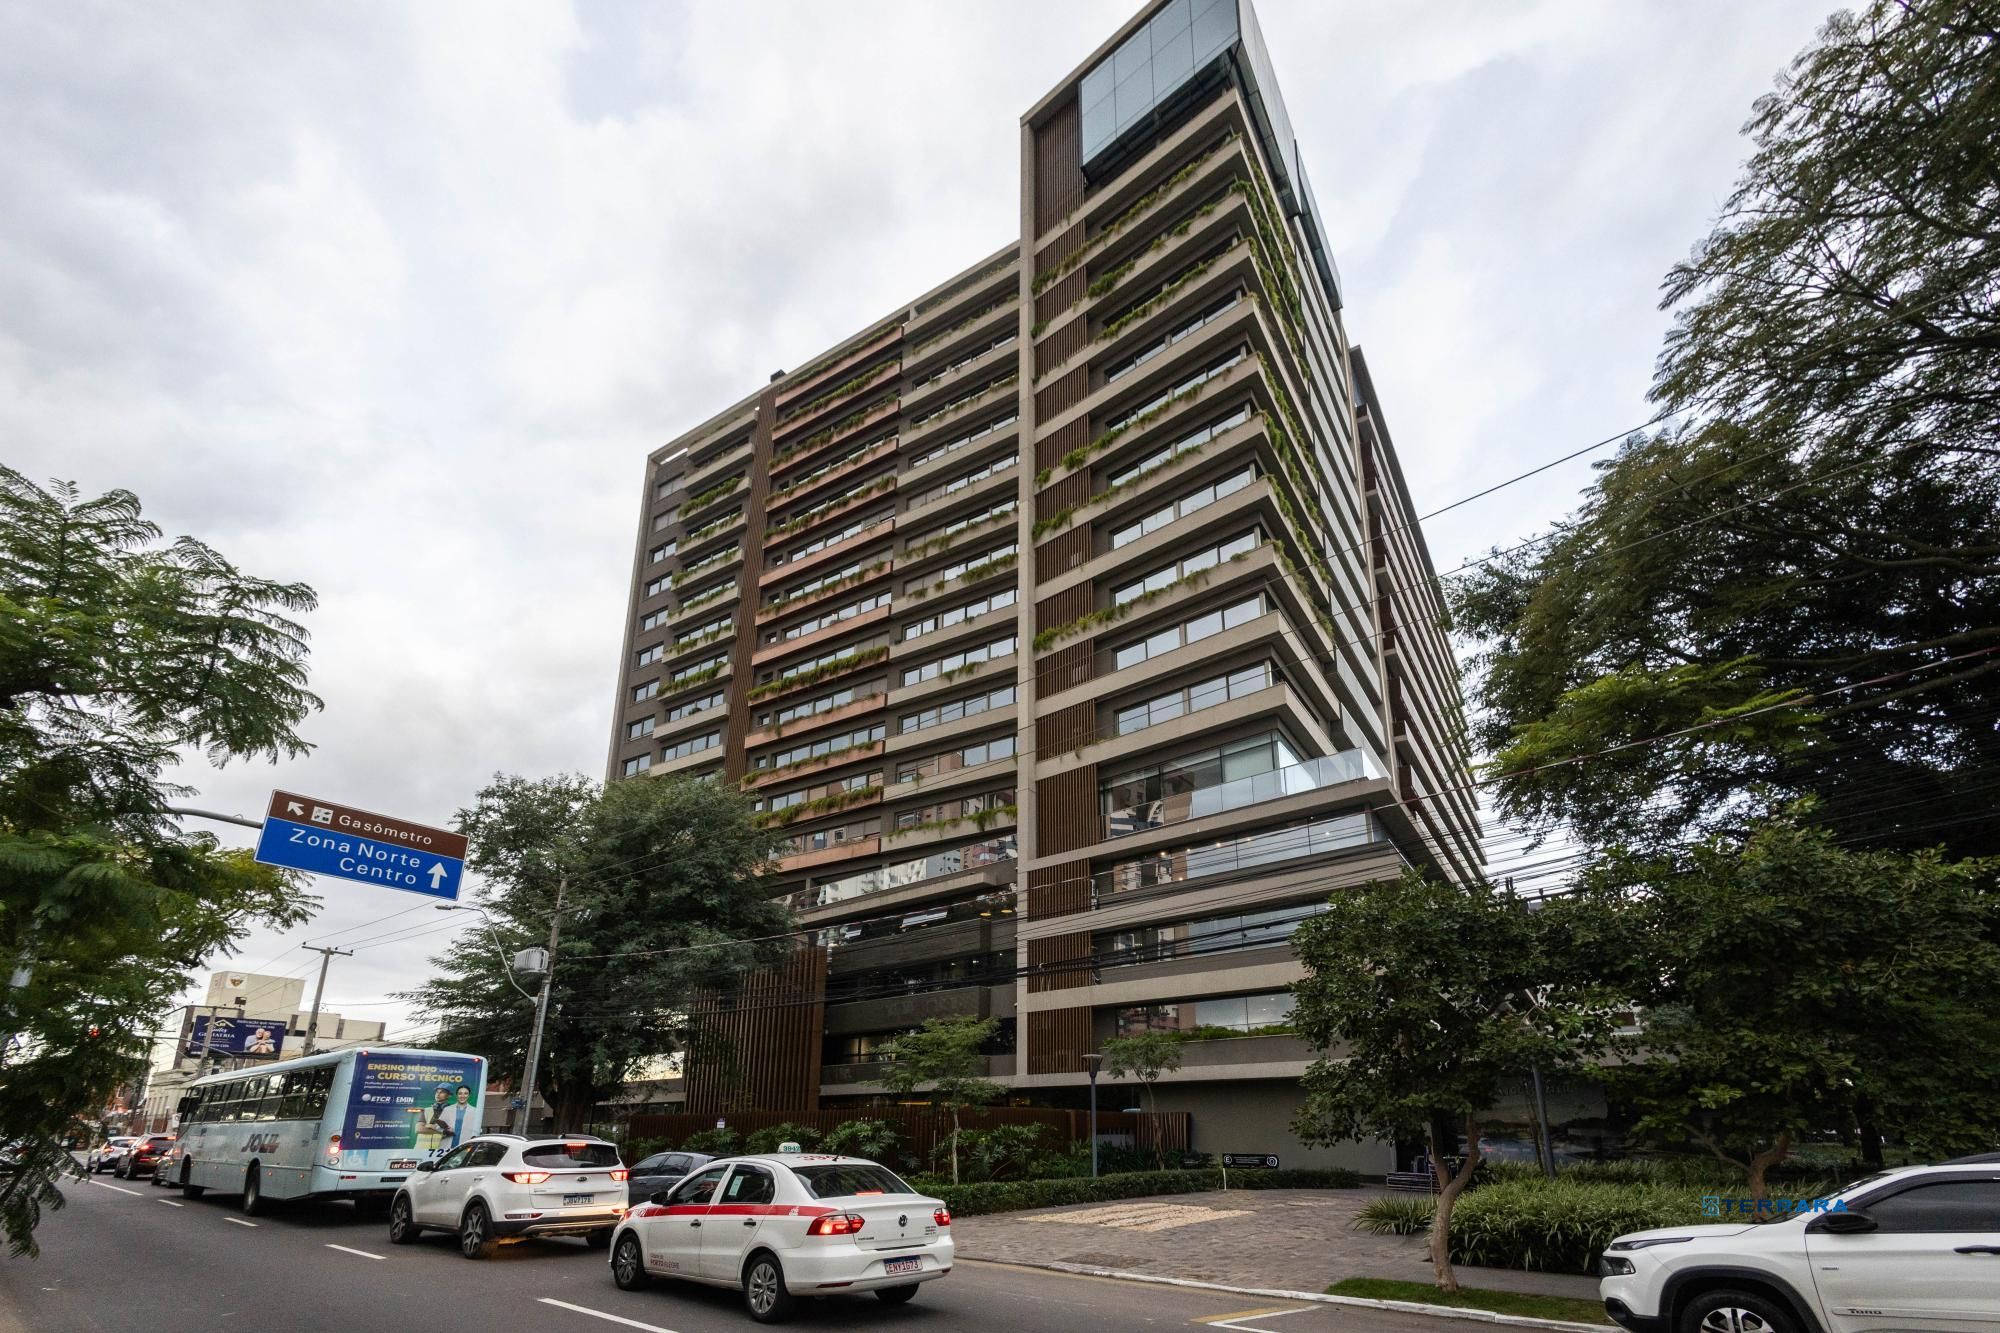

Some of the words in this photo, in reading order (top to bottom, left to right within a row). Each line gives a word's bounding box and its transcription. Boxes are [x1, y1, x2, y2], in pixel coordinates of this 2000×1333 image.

[339, 815, 432, 845] Gasômetro
[290, 828, 351, 853] Zona
[357, 843, 421, 868] Norte
[339, 857, 417, 885] Centro
[367, 1063, 405, 1071] ENSINO
[407, 1064, 437, 1073] MÉDIO
[377, 1072, 416, 1081] CURSO
[418, 1072, 463, 1083] TÉCNICO
[428, 1148, 452, 1158] 72
